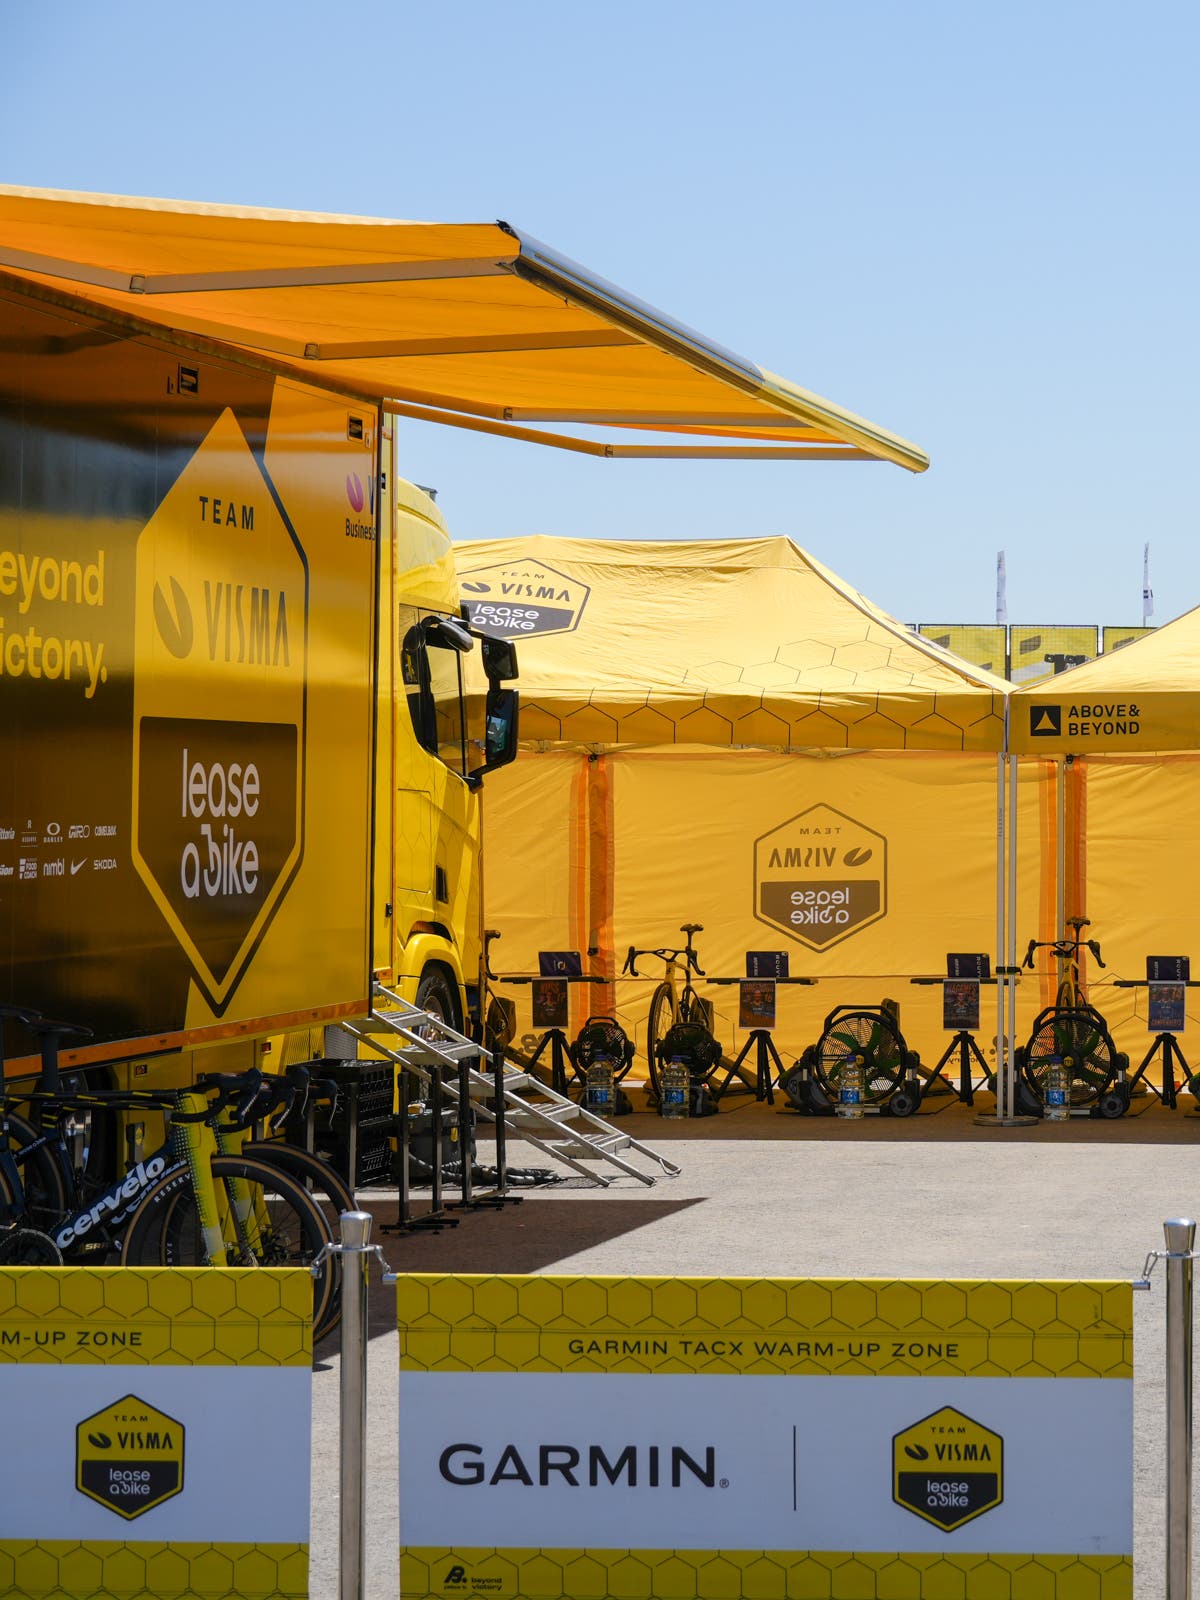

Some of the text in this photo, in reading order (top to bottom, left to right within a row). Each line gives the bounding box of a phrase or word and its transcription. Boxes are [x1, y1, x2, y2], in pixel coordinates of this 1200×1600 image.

[199, 495, 255, 530] TEAM
[0, 550, 104, 614] eyond
[501, 571, 545, 579] TEAM
[501, 583, 570, 602] VISMA
[475, 603, 540, 620] lease
[203, 580, 290, 667] VISMA
[1068, 721, 1140, 736] BEYOND
[181, 748, 260, 818] lease
[43, 858, 65, 876] nimbl
[154, 1173, 191, 1203] RESERV
[1, 1331, 142, 1347] M-UP ZONE
[568, 1339, 960, 1358] GARMIN TACX WARM-UP ZONE
[930, 1426, 966, 1434] TEAM
[117, 1431, 173, 1450] VISMA
[935, 1443, 991, 1462] VISMA
[109, 1467, 151, 1482] lease
[927, 1479, 969, 1494] lease
